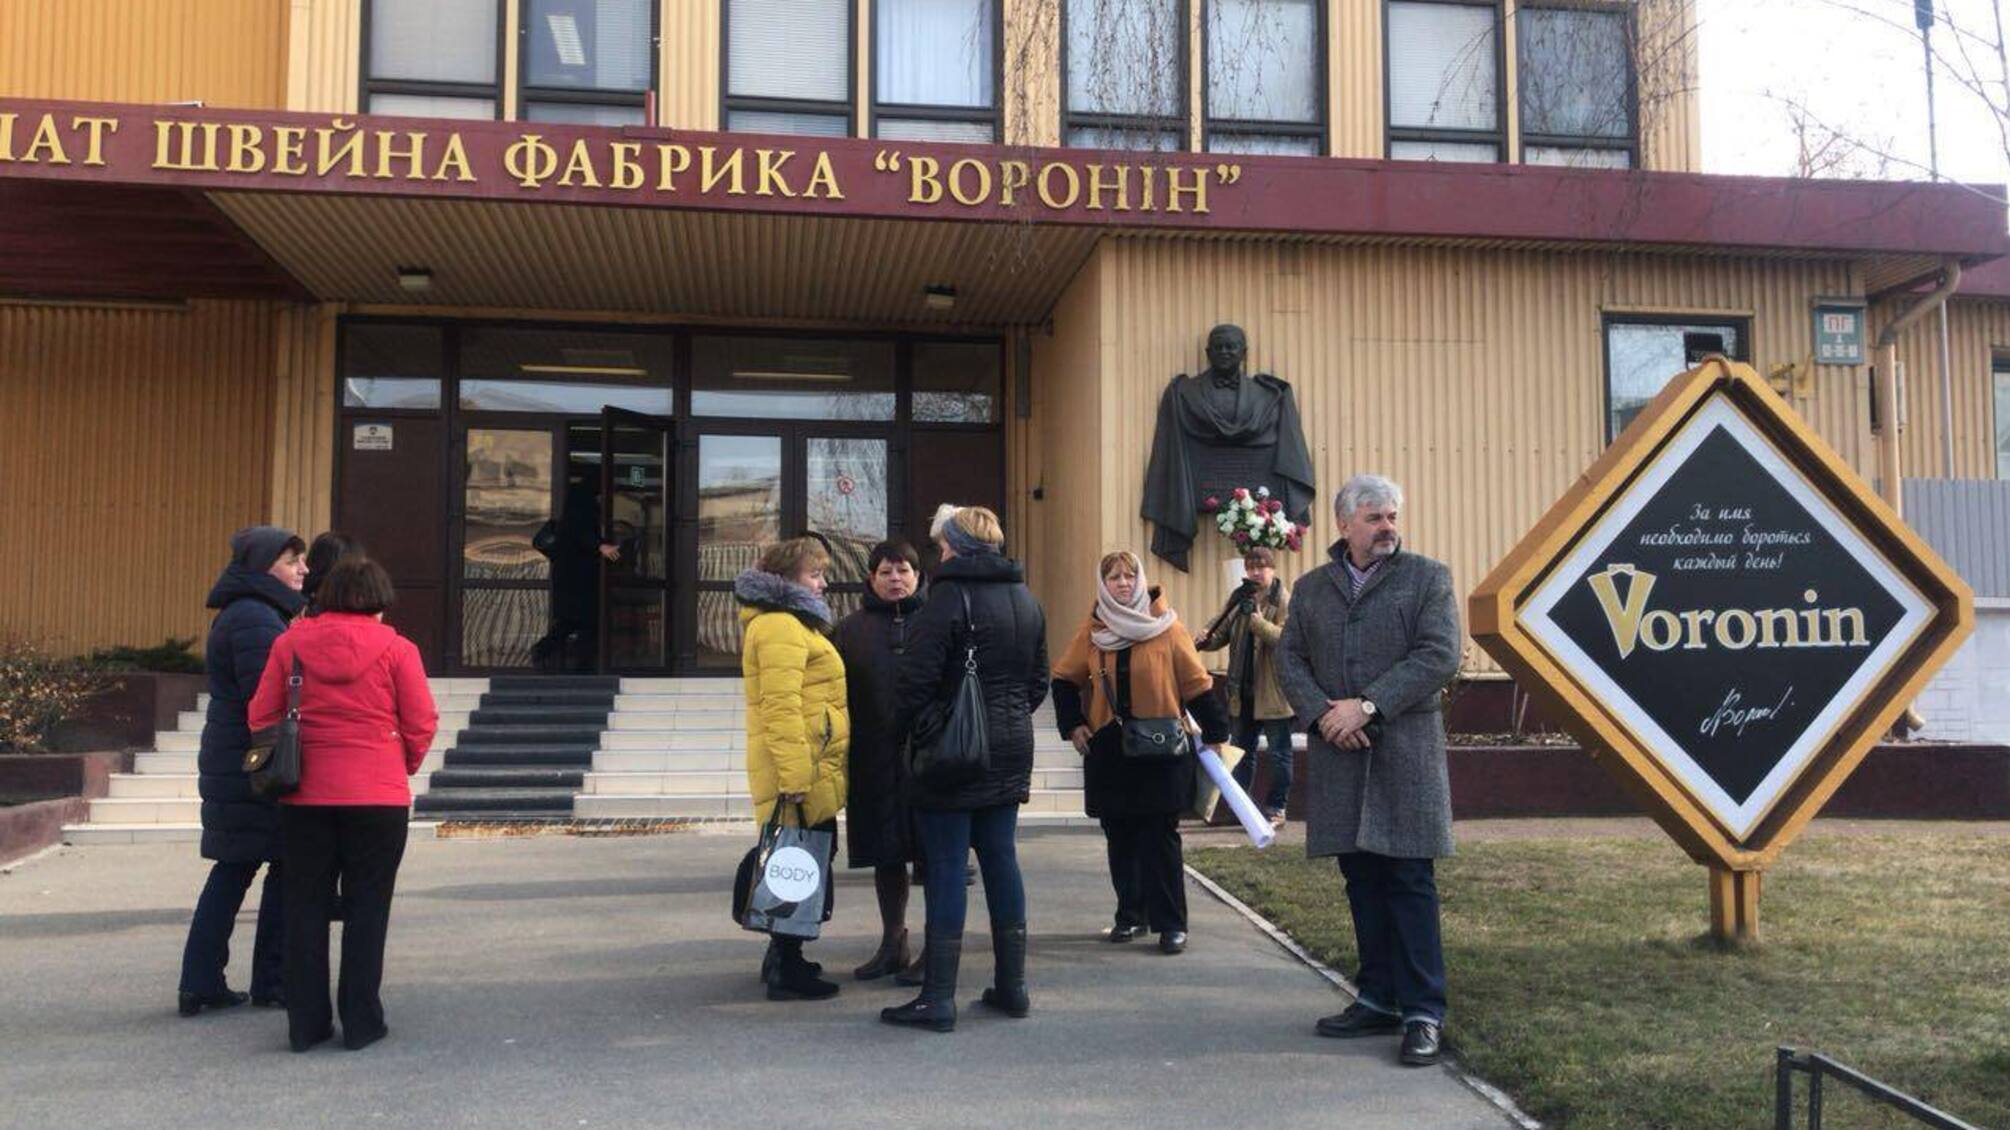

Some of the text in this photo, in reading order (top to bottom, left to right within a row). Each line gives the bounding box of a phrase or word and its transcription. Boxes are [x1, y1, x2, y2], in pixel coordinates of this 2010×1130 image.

[151, 118, 477, 182] ШВЕЙНА
[503, 133, 846, 200] ФАБРИКА
[1689, 504, 1752, 521] За имя
[1639, 523, 1812, 552] необходимо бороться
[1672, 552, 1785, 571] каждый день!
[1587, 563, 1871, 660] Voronin
[770, 865, 814, 881] BODY
